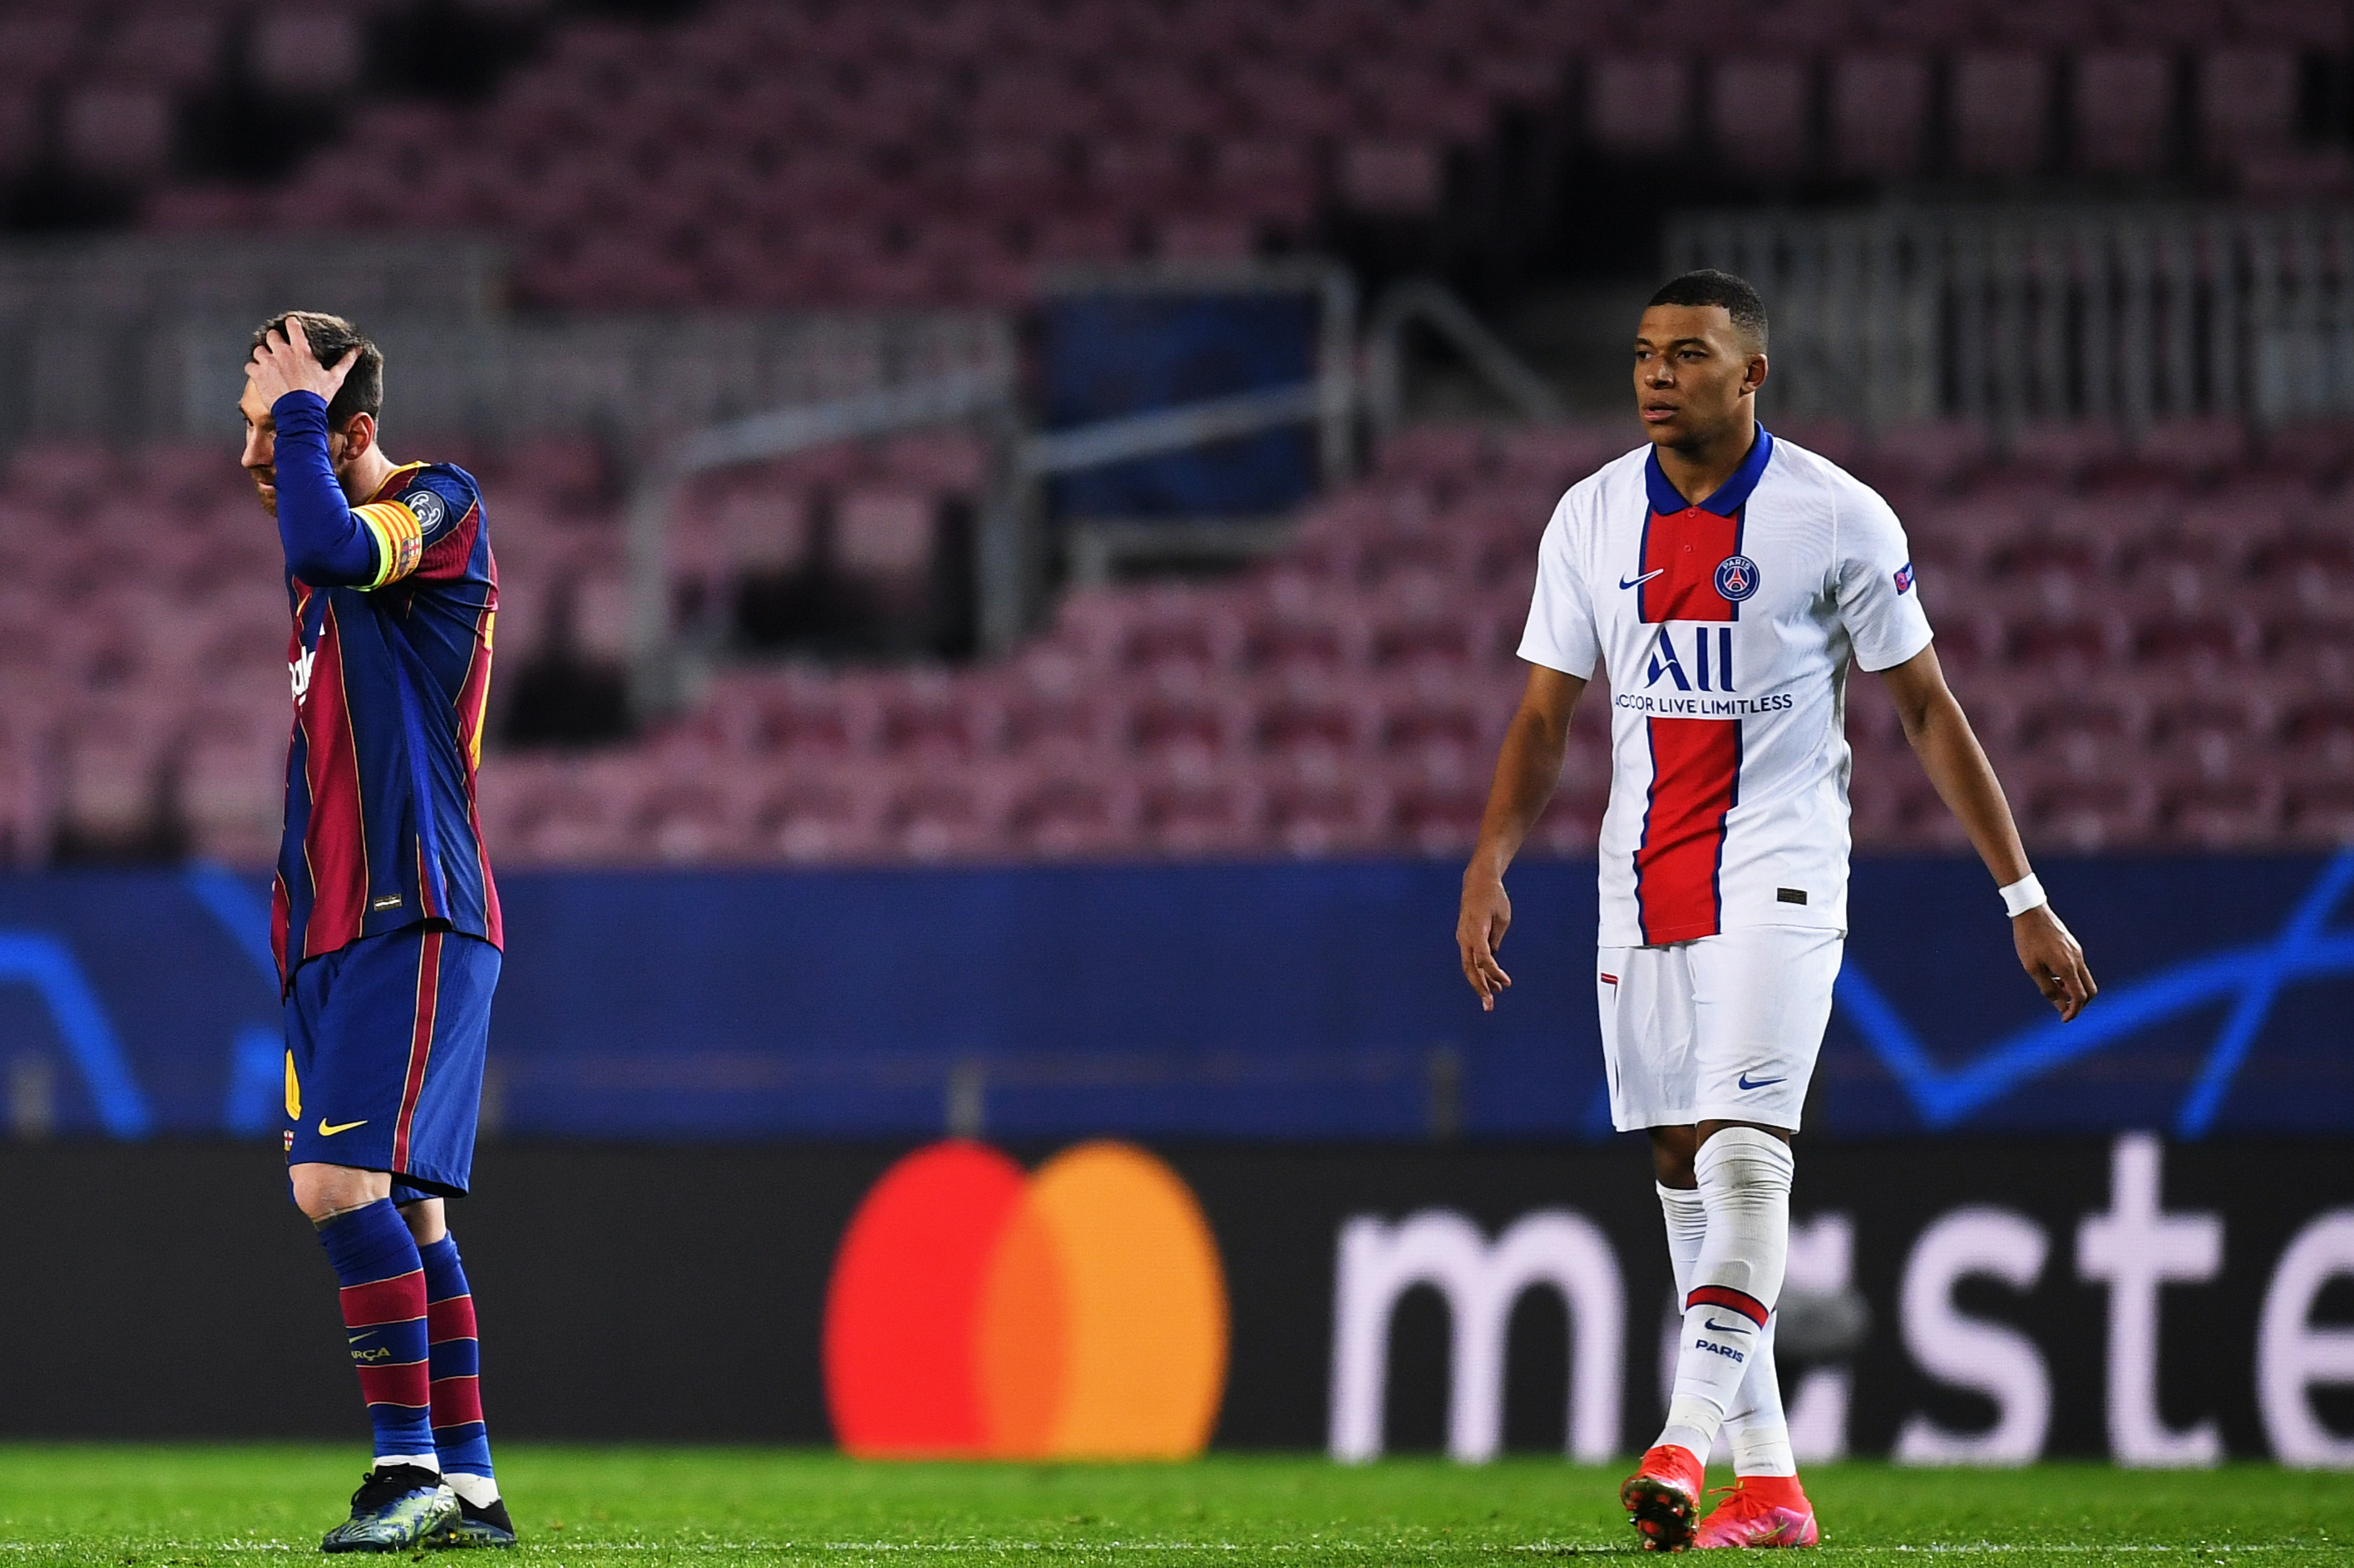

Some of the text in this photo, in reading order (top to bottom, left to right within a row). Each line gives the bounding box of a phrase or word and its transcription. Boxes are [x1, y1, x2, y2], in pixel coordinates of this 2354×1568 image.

[1721, 558, 1752, 570] PARIS
[1659, 698, 1697, 713] LIVE
[1700, 693, 1793, 715] LIMITLESS
[1695, 1339, 1745, 1363] PARIS
